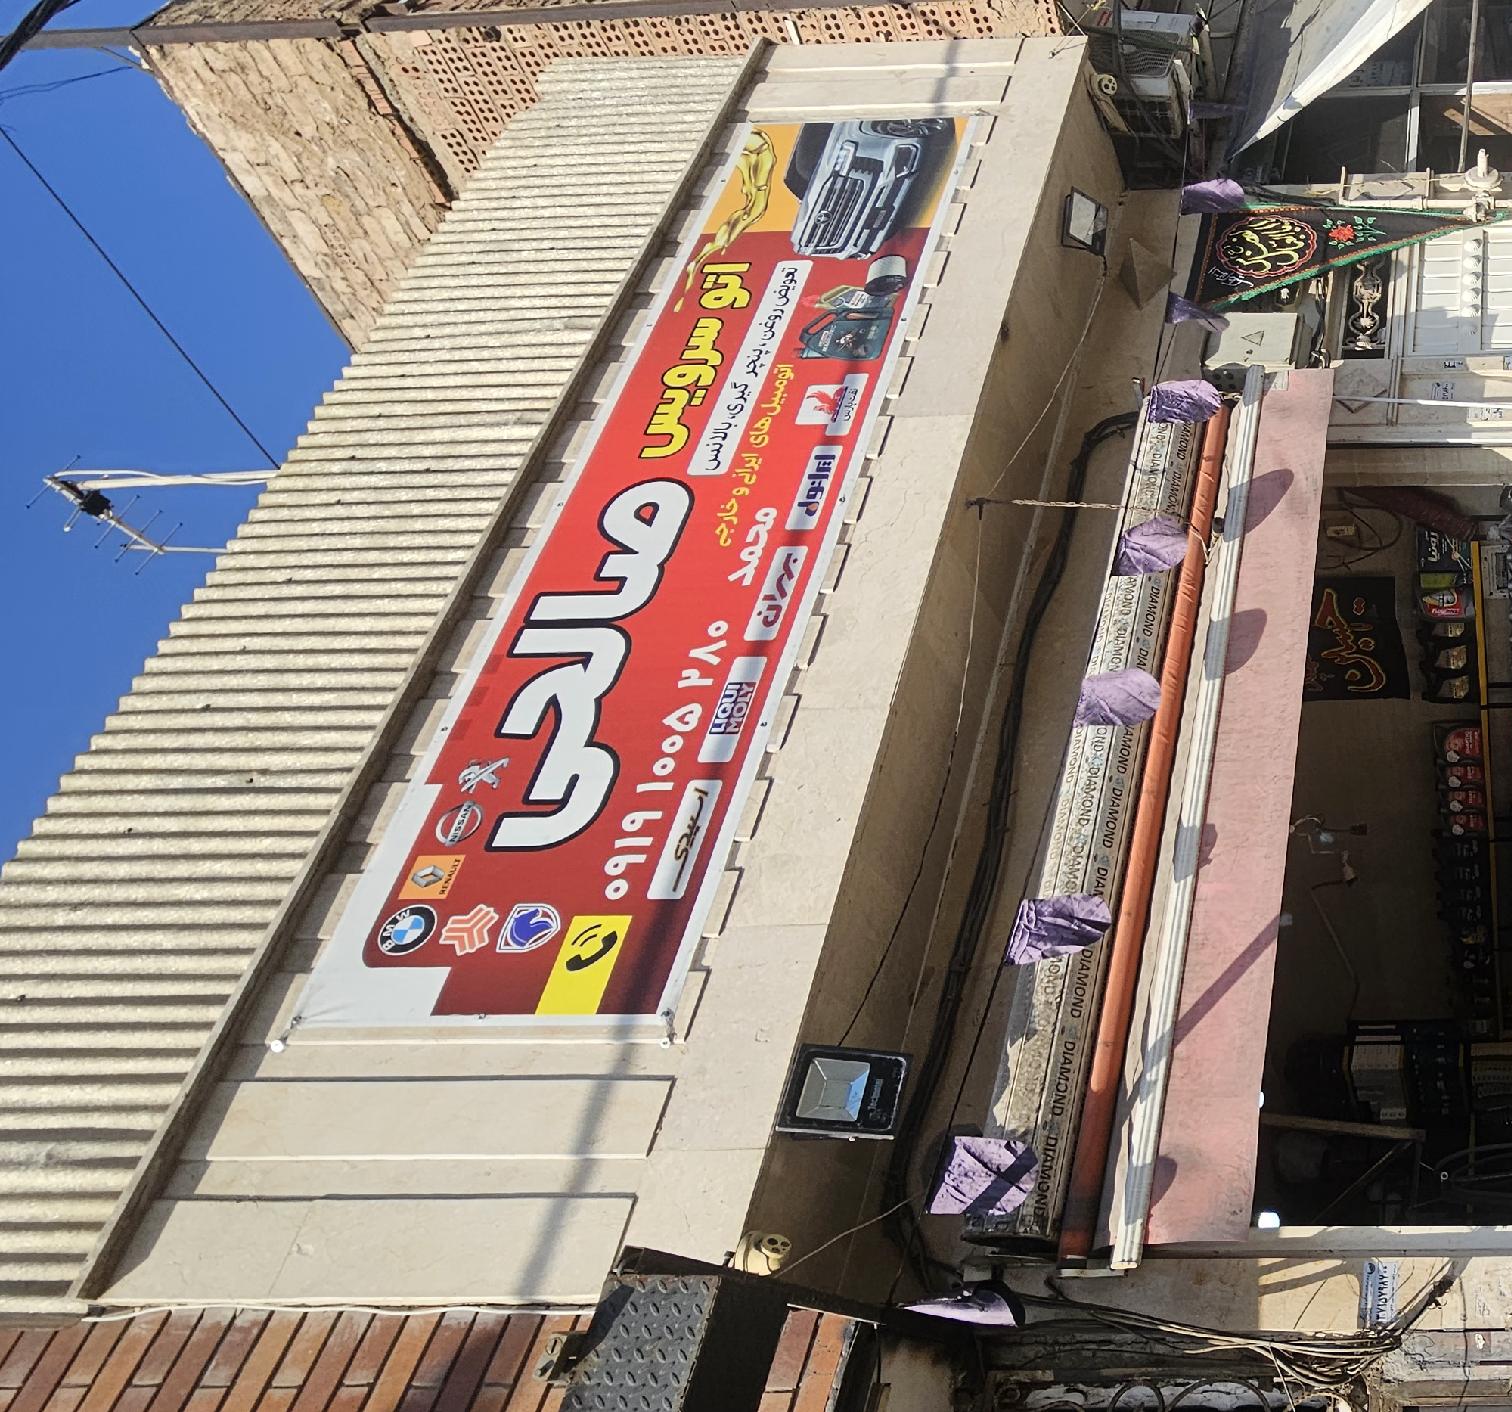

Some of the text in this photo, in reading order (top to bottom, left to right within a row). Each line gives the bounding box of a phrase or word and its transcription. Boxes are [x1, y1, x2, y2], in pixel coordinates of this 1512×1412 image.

[771, 267, 799, 307] تعویض
[638, 262, 752, 459] اتو سرویس
[743, 348, 769, 378] پنچر
[702, 421, 734, 472] بالانس
[712, 363, 795, 548] اتومبیل های ایرانی و خارجی
[728, 507, 778, 587] محمد
[1120, 575, 1138, 616] AMOND
[1142, 585, 1161, 638] DIAMOND
[484, 477, 695, 851] صالحی
[709, 682, 738, 734] LIQUI
[726, 682, 755, 734] MOLY
[603, 619, 729, 900] ۰۹۱۹ ۱۰۰۵ ۲۸۰
[449, 803, 473, 844] NISSAN
[1077, 766, 1101, 828] DIAMOND
[1102, 786, 1123, 849] DIAMOND
[437, 858, 462, 896] RENAULT
[382, 909, 410, 951] BMW
[1069, 948, 1094, 1019] DIAMOND
[1050, 1040, 1076, 1117] DIAMOND
[1033, 1135, 1059, 1218] DIAMOND
